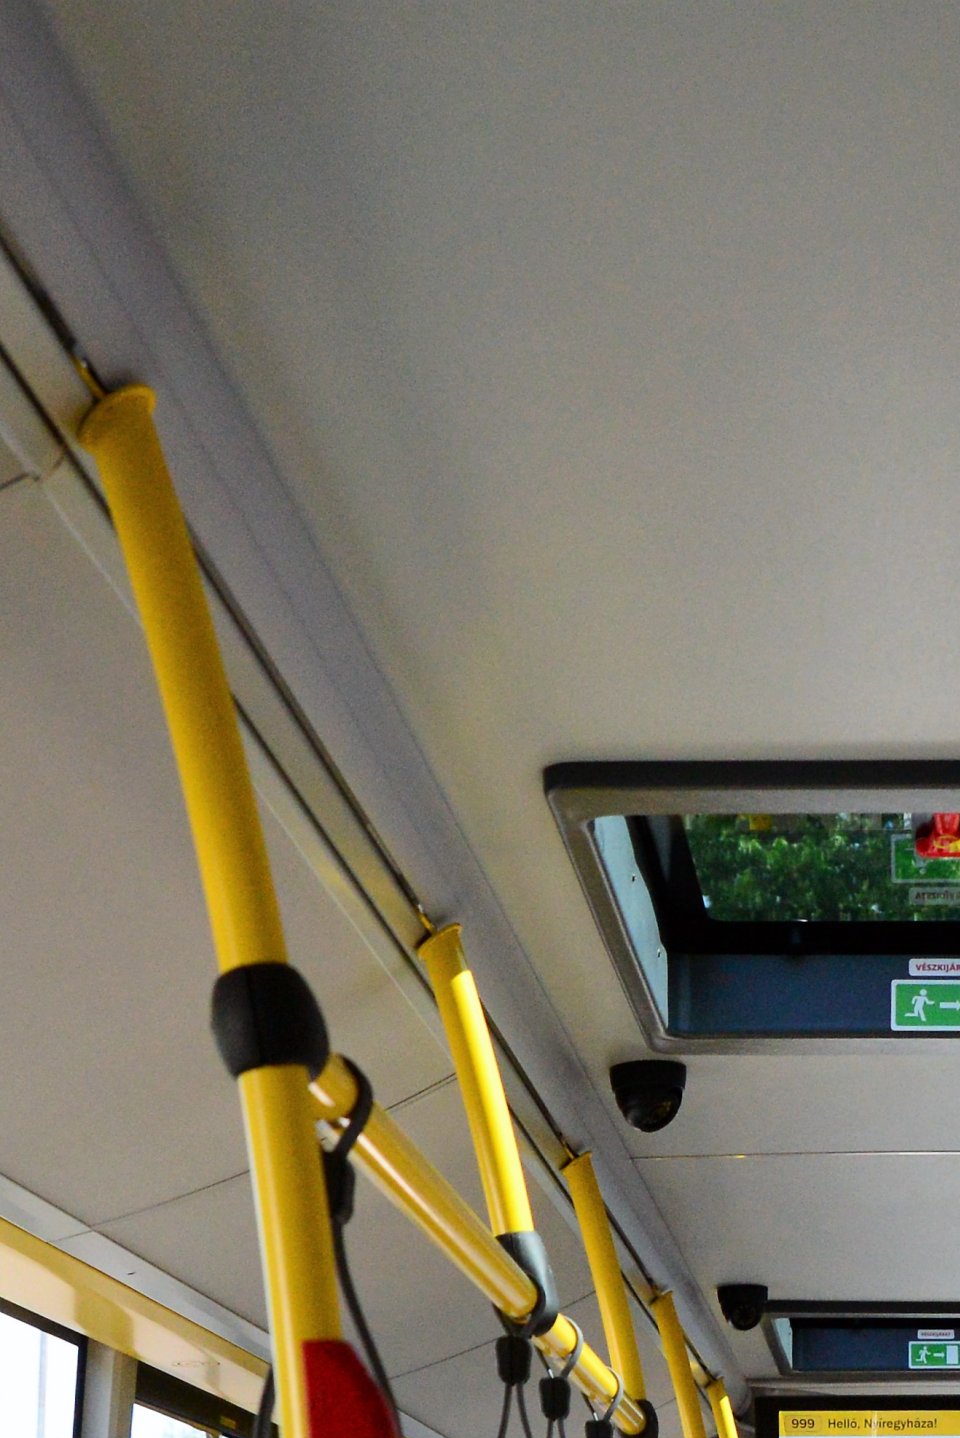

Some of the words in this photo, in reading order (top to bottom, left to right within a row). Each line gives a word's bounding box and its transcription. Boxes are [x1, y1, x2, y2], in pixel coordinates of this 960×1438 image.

[791, 1418, 816, 1429] 999
[827, 1416, 861, 1430] Helló,
[864, 1416, 938, 1431] Nyíregyháza!
